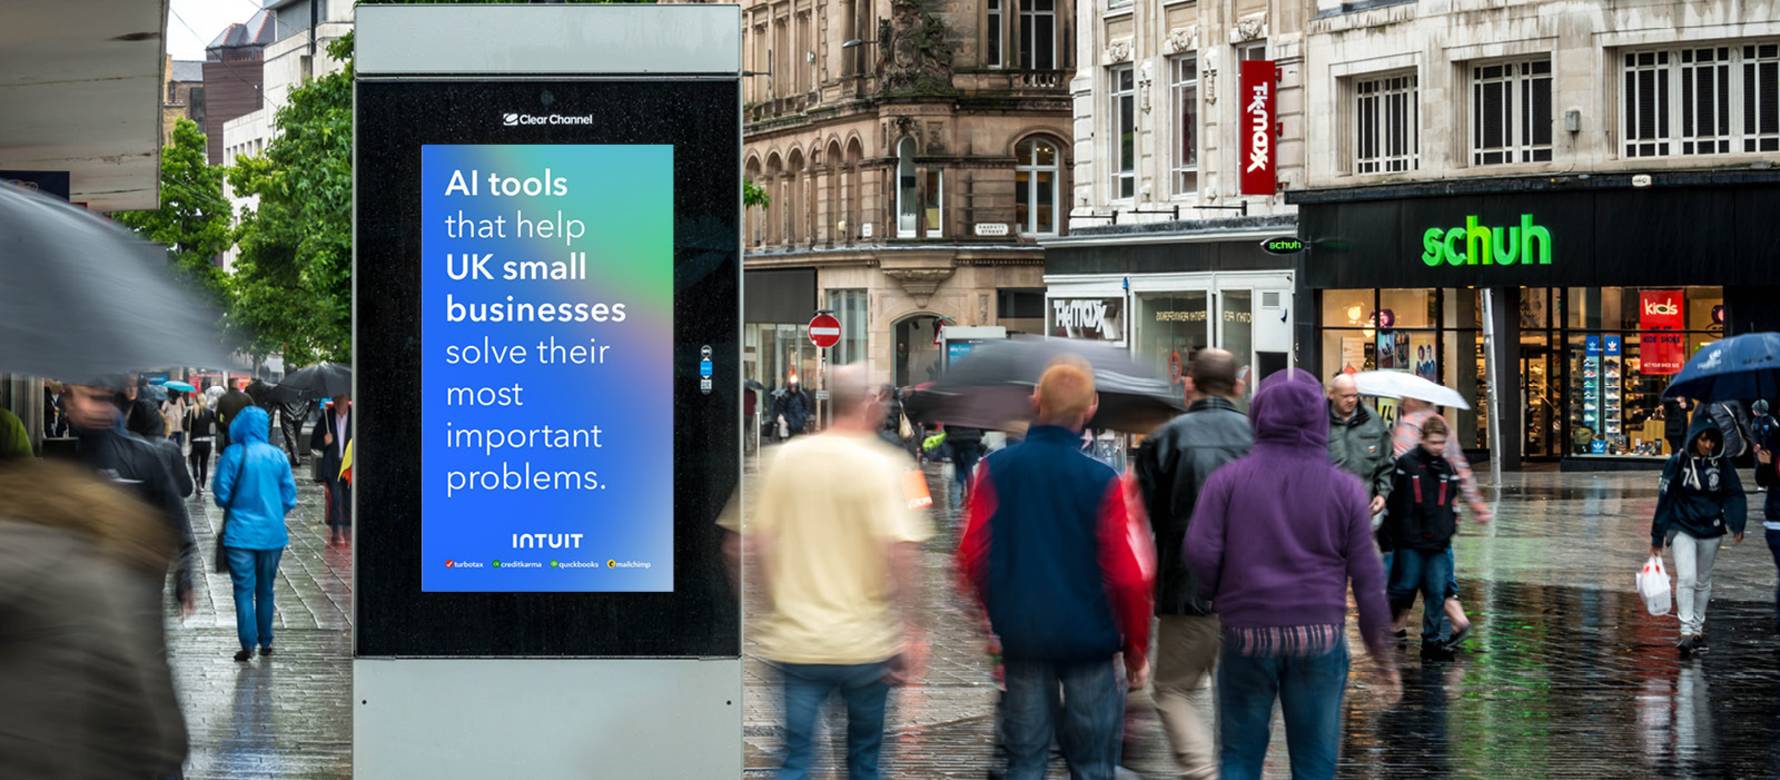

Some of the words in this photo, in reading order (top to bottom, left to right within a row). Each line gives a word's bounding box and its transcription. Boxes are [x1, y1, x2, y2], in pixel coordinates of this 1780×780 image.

[519, 114, 548, 125] Clear
[549, 114, 593, 125] Channel
[445, 169, 478, 196] AI
[488, 168, 568, 197] tools
[445, 210, 506, 239] that
[517, 210, 586, 246] help
[1268, 240, 1303, 250] schuh
[1421, 213, 1553, 267] schuh
[447, 253, 495, 280] UK
[503, 252, 587, 280] small
[447, 294, 626, 322] businesses
[1644, 297, 1679, 316] kids
[446, 336, 527, 365] solve
[537, 336, 610, 364] their
[447, 383, 524, 406] most
[447, 422, 603, 456] important
[447, 462, 607, 498] problems.
[512, 533, 584, 549] INTUIT
[454, 560, 484, 569] turbotax
[500, 560, 543, 569] creditkarma
[559, 560, 599, 570] quickbooks
[615, 560, 652, 570] mailchimp
